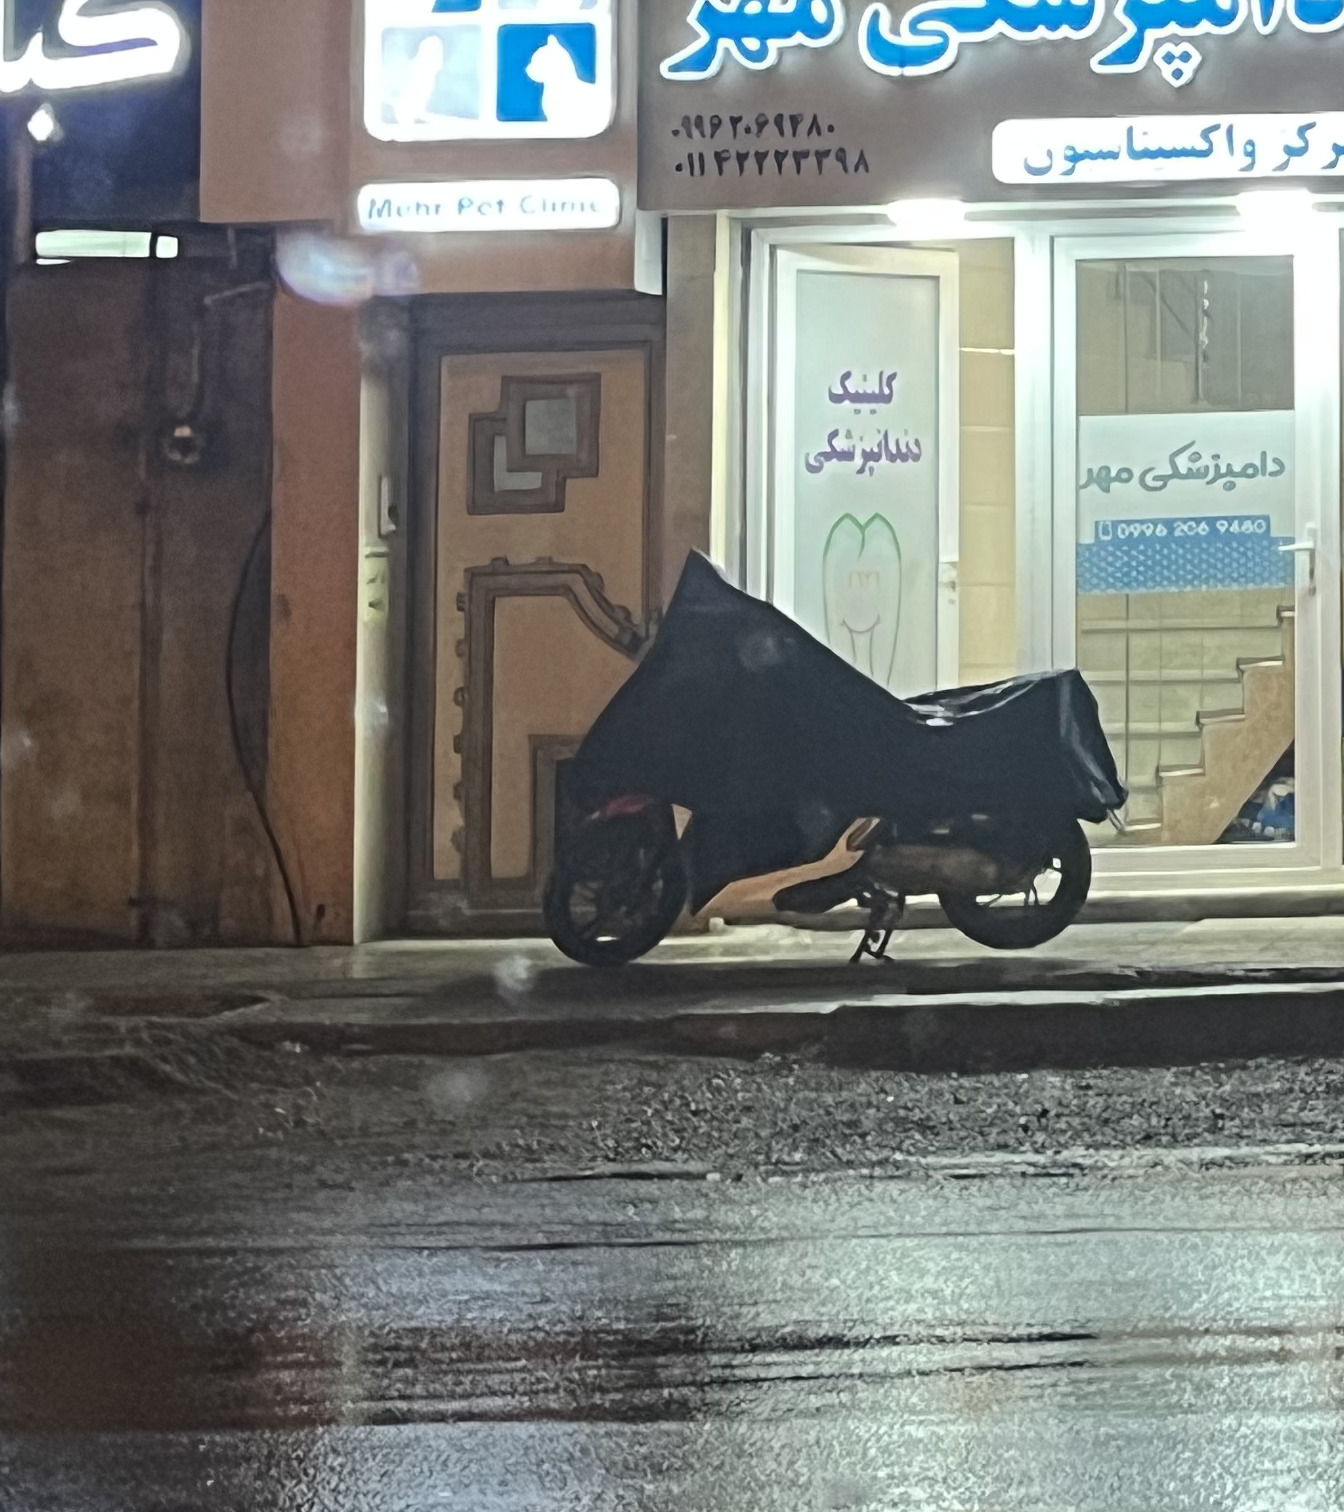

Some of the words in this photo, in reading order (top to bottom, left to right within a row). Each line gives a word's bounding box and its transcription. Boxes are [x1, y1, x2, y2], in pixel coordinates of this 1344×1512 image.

[828, 370, 897, 414] کلینیک
[804, 428, 922, 477] دندانپزشکی
[1138, 440, 1285, 491] دامپزشکی
[1079, 465, 1134, 494] مهر
